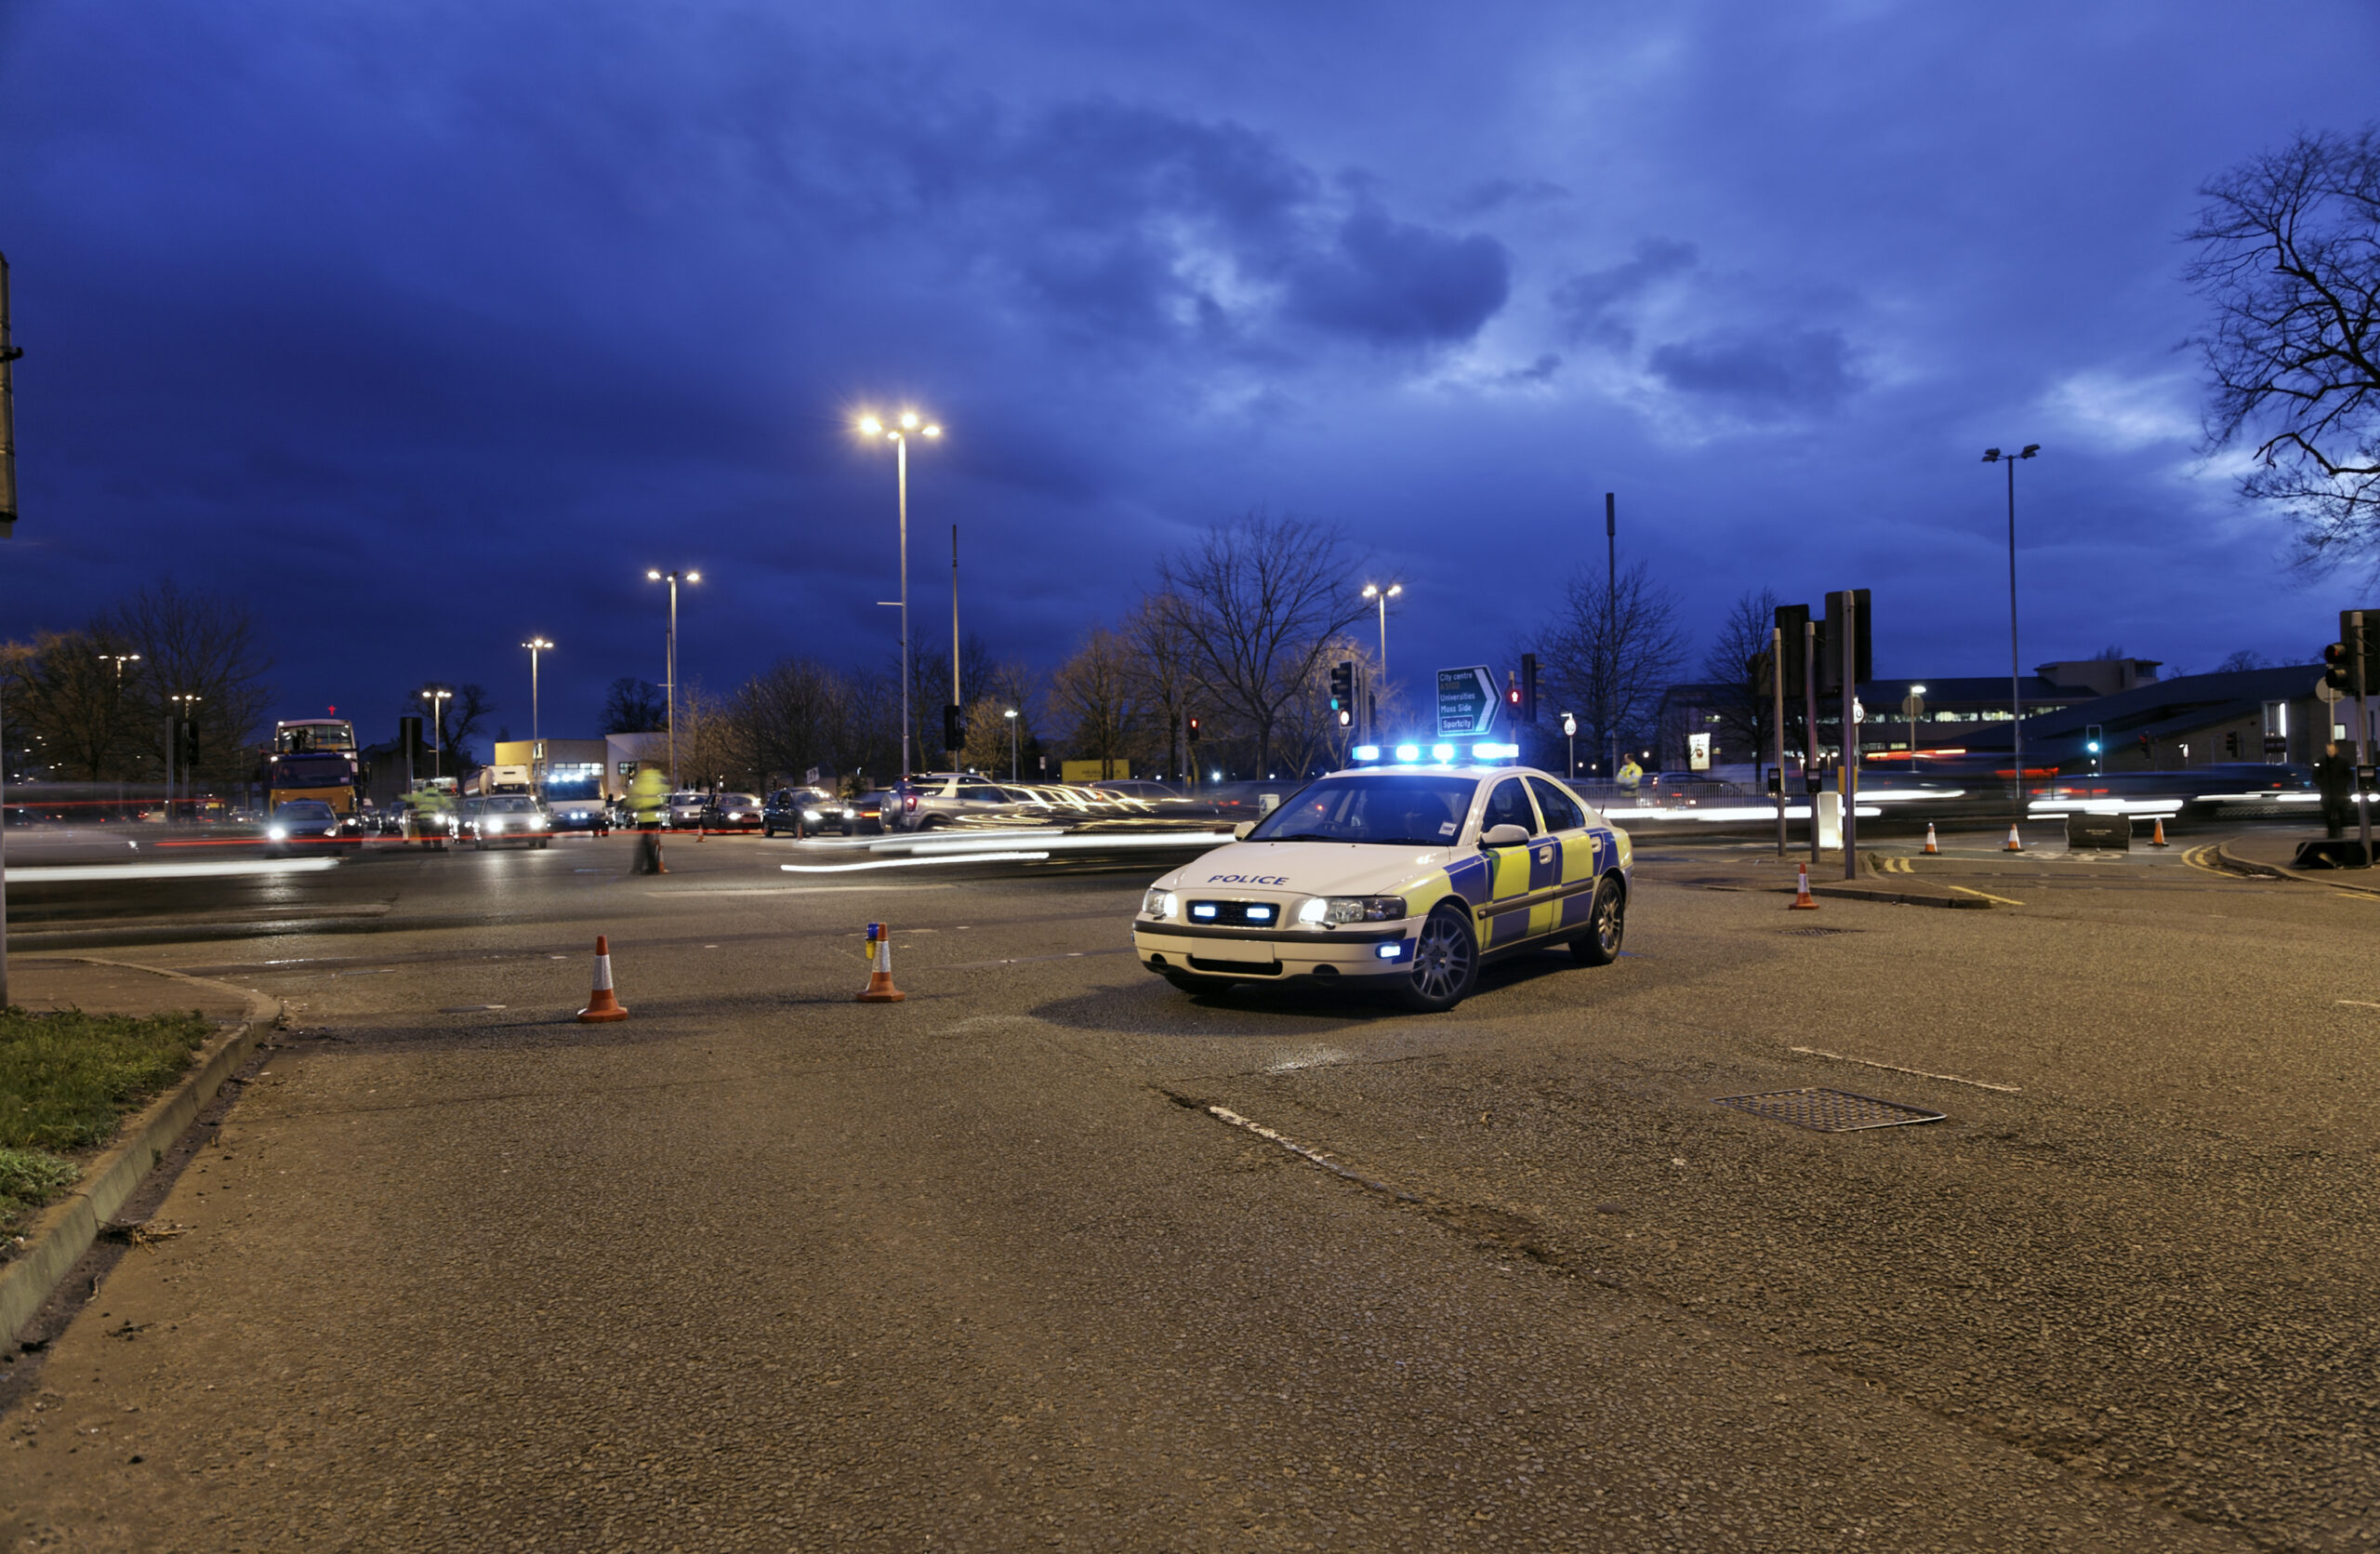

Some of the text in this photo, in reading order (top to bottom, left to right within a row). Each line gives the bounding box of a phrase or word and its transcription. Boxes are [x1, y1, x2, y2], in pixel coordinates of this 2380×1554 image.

[1439, 673, 1451, 682] City
[1440, 693, 1475, 702] Universities
[1458, 703, 1472, 712] Side
[1443, 720, 1471, 729] Sportcity
[1208, 874, 1289, 885] POLICE
